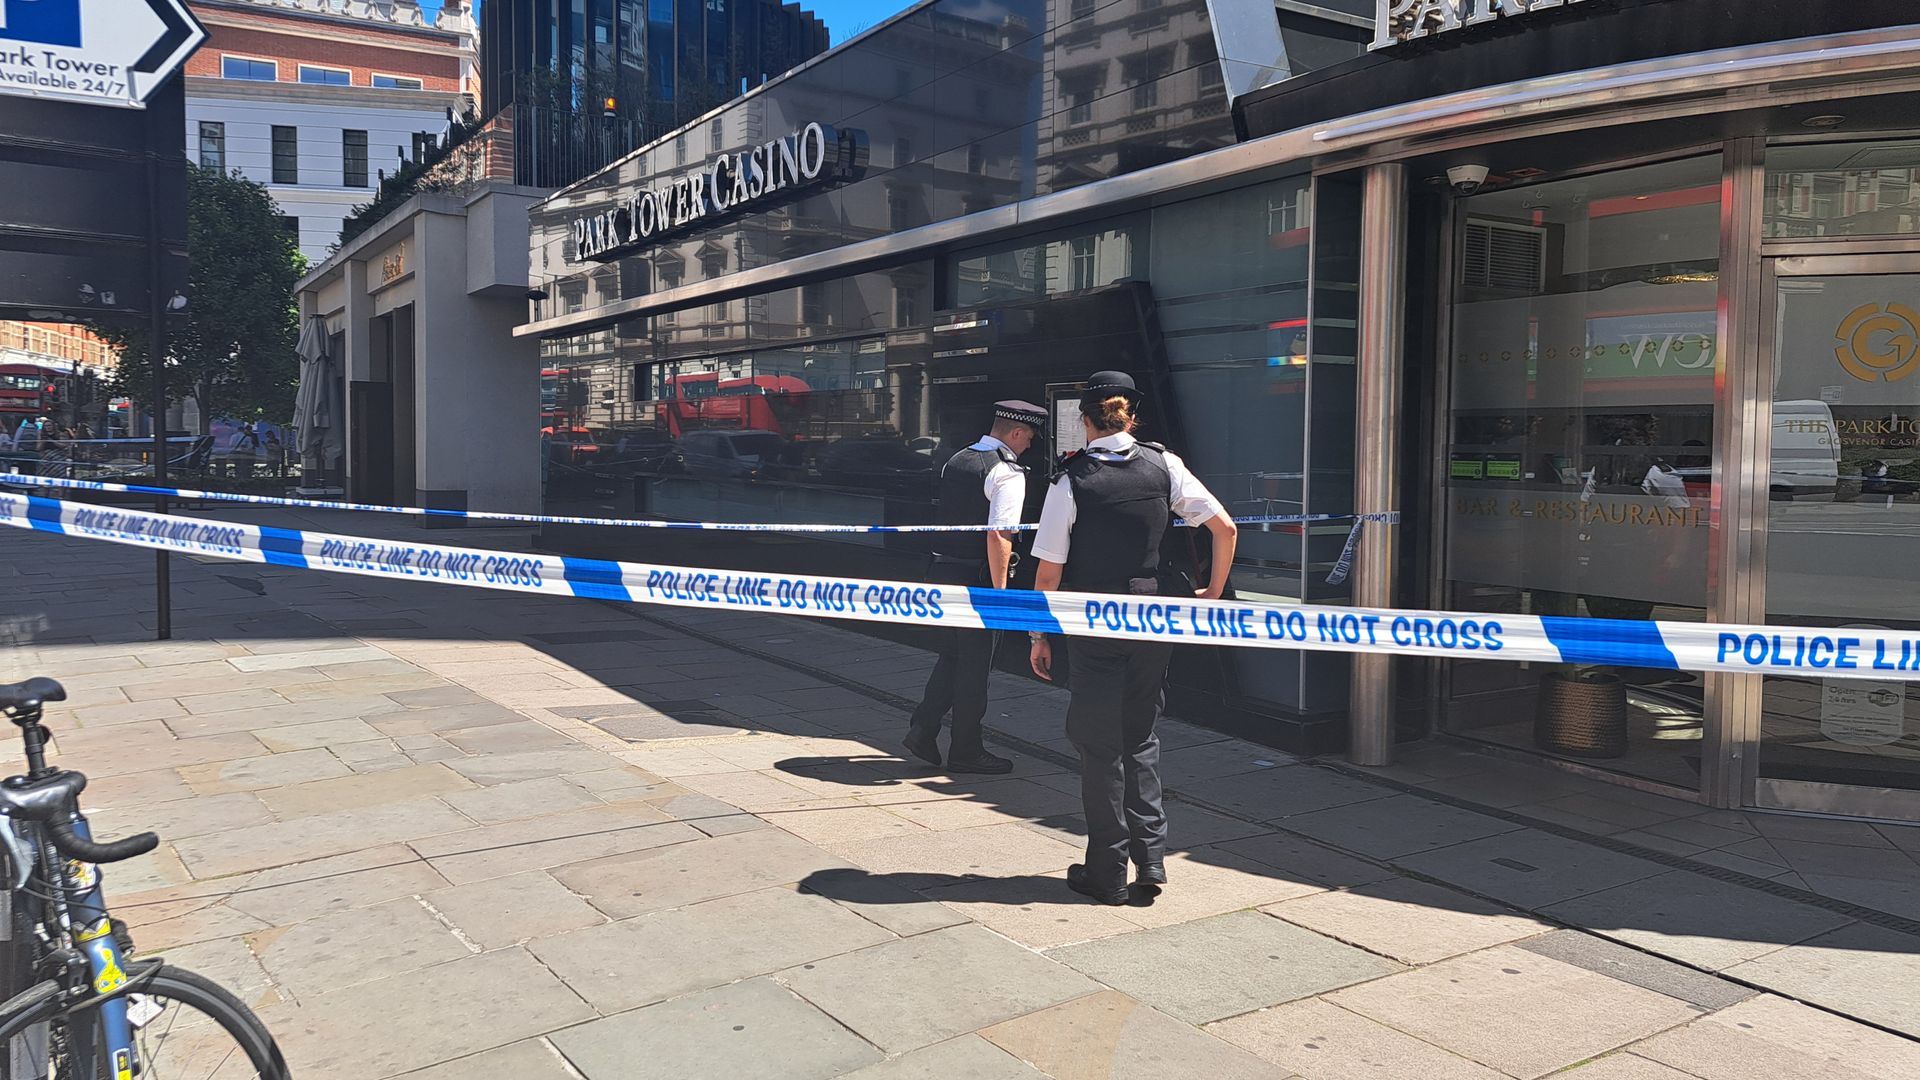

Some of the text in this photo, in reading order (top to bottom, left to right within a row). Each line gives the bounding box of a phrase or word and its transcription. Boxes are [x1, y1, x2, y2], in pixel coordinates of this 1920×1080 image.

[42, 50, 118, 77] Tower
[82, 79, 125, 95] 24/7
[574, 122, 825, 261] PARK TOWER CASINO
[1785, 419, 1828, 433] THE
[1834, 419, 1890, 434] PARK
[75, 508, 245, 555] POLICE LINE DO NOT CROSS
[1456, 497, 1705, 529] BAR & RESTAURANT
[320, 539, 543, 587] POLICE LINE DO NOT CROSS
[646, 570, 944, 619] POLICE LINE DO NOT CROSS
[1085, 600, 1504, 651] POLICE LINE DO NOT CROSS
[1717, 632, 1861, 669] POLICE
